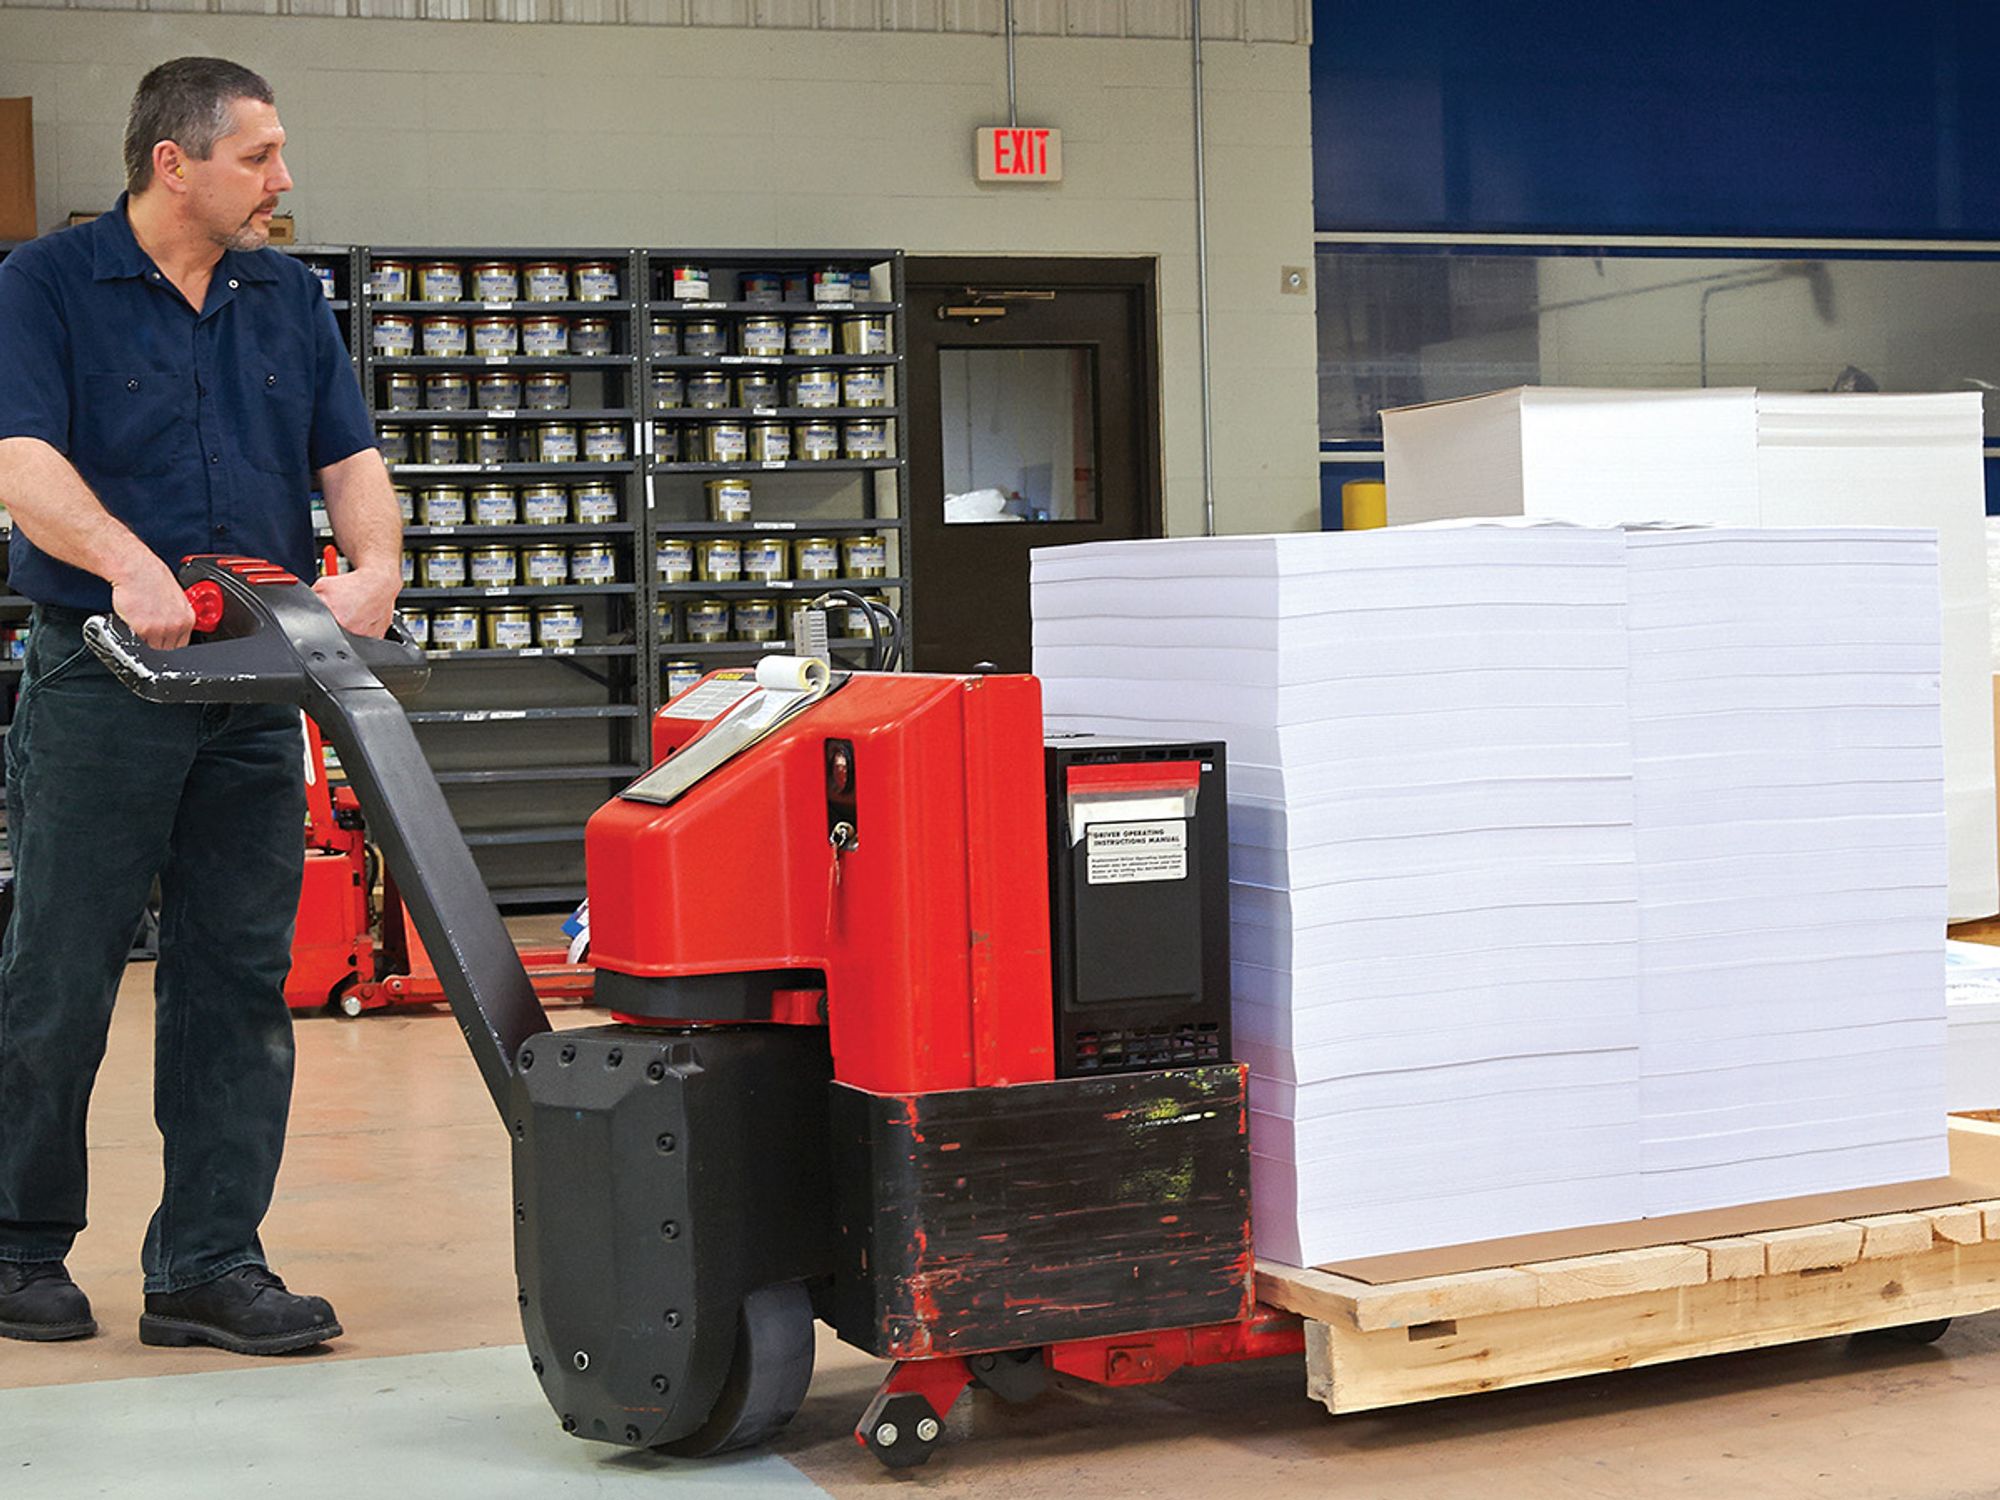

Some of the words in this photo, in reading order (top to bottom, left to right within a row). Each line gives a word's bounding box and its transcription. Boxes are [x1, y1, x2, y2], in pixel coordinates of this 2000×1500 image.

[994, 129, 1050, 175] EXIT
[1123, 829, 1164, 837] OPERATING
[1093, 838, 1146, 846] INSTRUCTIONS
